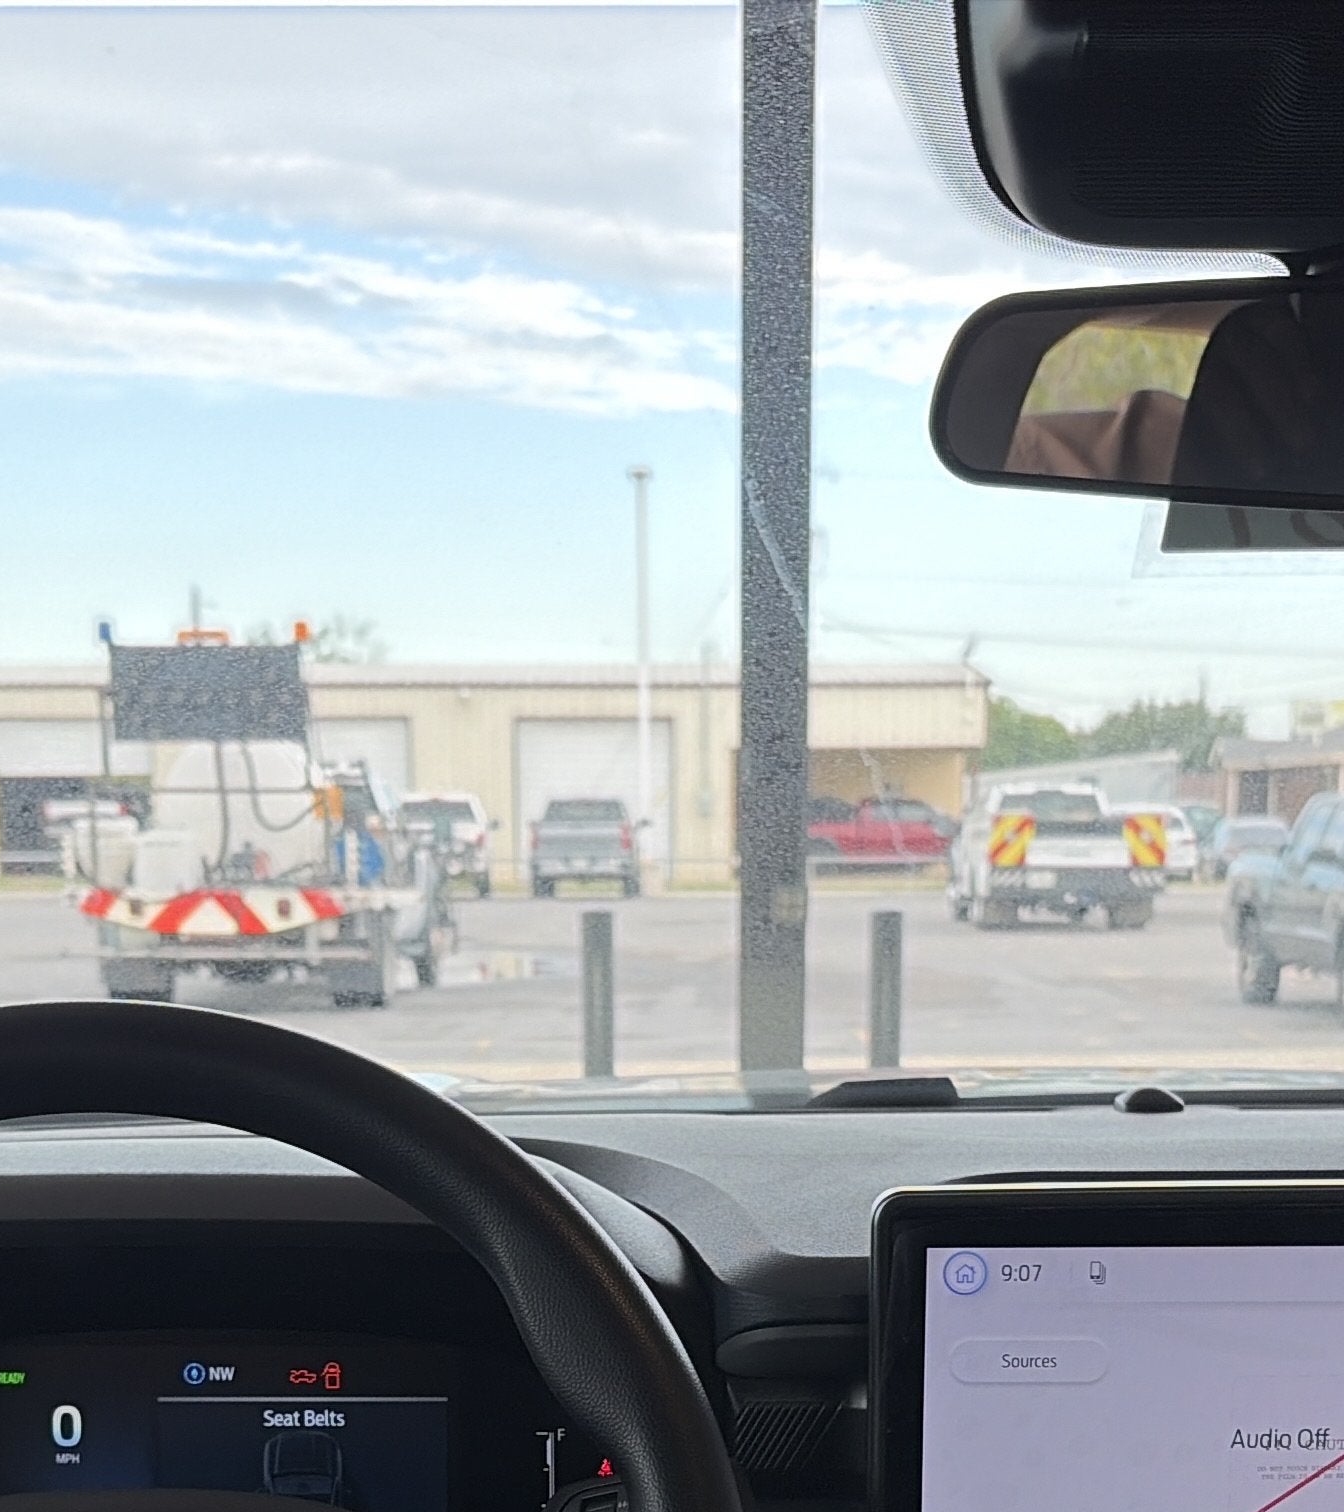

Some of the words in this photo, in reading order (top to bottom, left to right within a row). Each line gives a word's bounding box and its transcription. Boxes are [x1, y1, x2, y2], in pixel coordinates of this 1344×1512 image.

[1000, 1264, 1043, 1284] 9:07
[1001, 1353, 1058, 1369] Sources
[208, 1366, 235, 1382] NW
[51, 1404, 82, 1448] 0
[263, 1410, 300, 1427] Seat
[304, 1410, 345, 1427] Belts
[1230, 1428, 1291, 1449] Audio
[1297, 1428, 1330, 1449] Off
[56, 1453, 80, 1464] MPH
